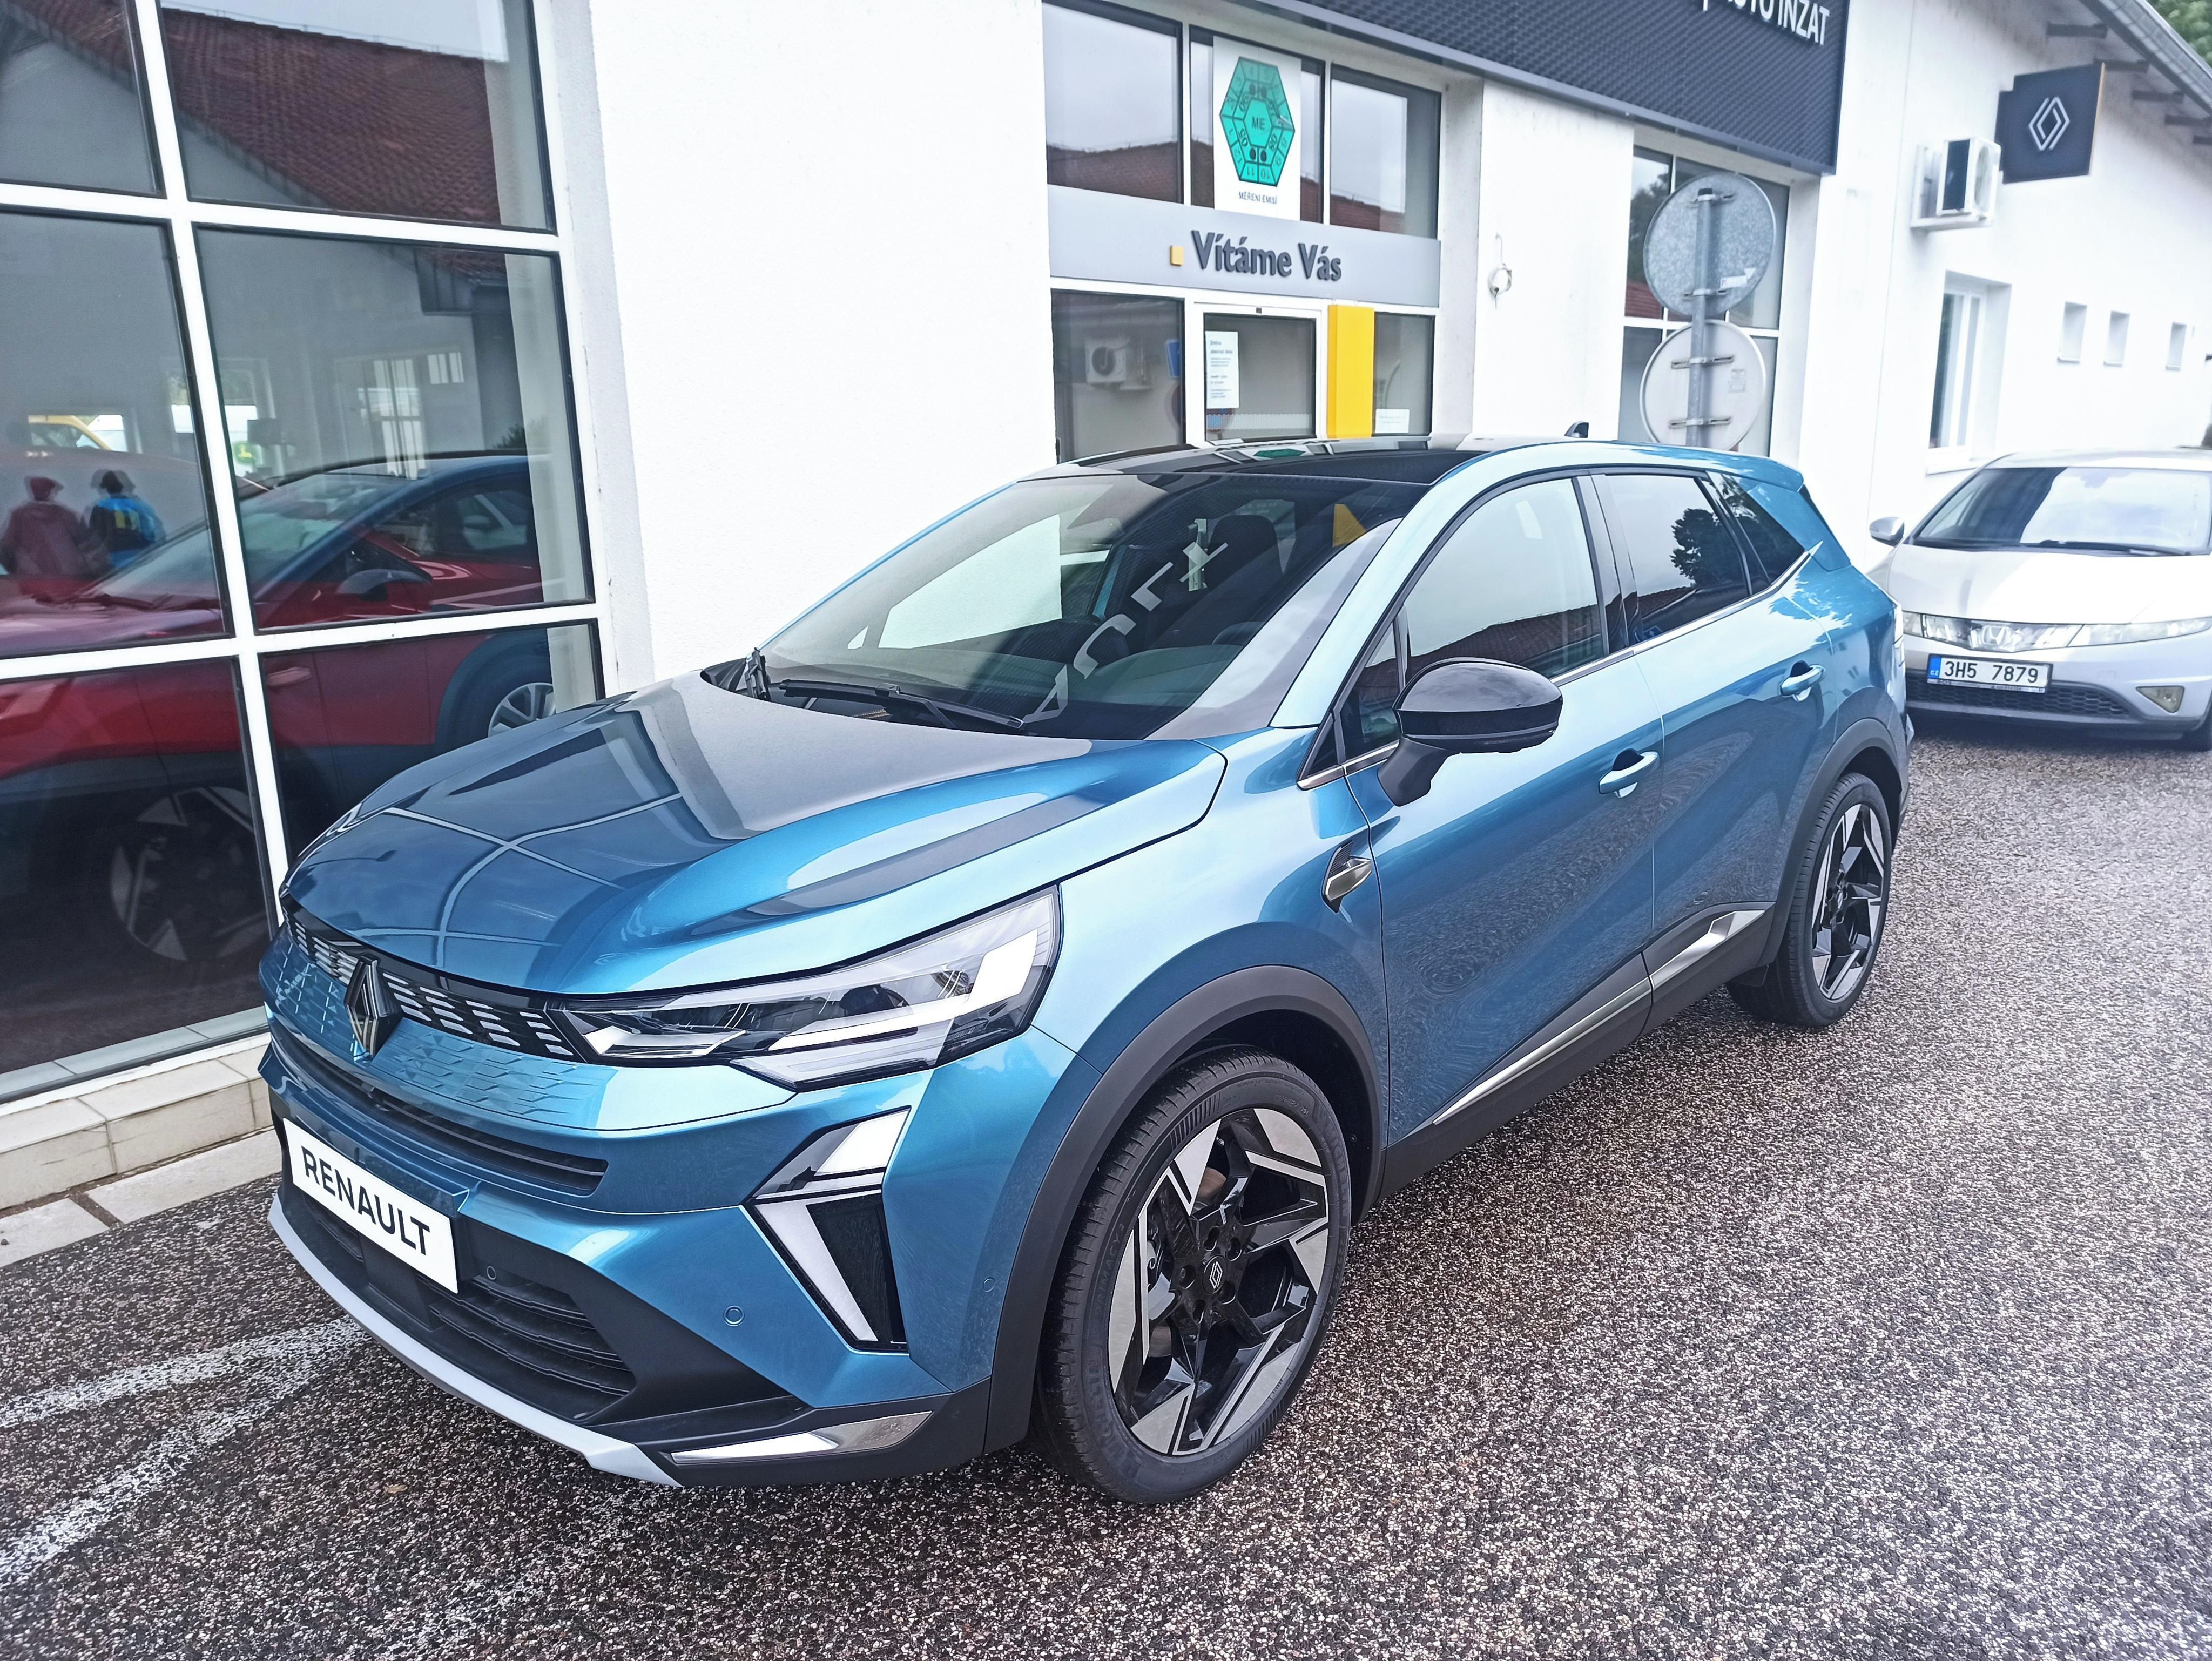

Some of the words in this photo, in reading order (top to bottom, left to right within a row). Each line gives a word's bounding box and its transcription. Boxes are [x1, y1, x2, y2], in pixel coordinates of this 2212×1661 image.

[1777, 0, 1830, 45] INZAT
[1251, 116, 1266, 130] ME
[1191, 230, 1292, 278] Vítáme
[1298, 242, 1342, 281] Vás
[1944, 660, 1978, 679] 3H5
[1992, 665, 2039, 684] 7879
[300, 1145, 430, 1256] RENAULT
[1095, 1232, 1121, 1315] PRIMACY
